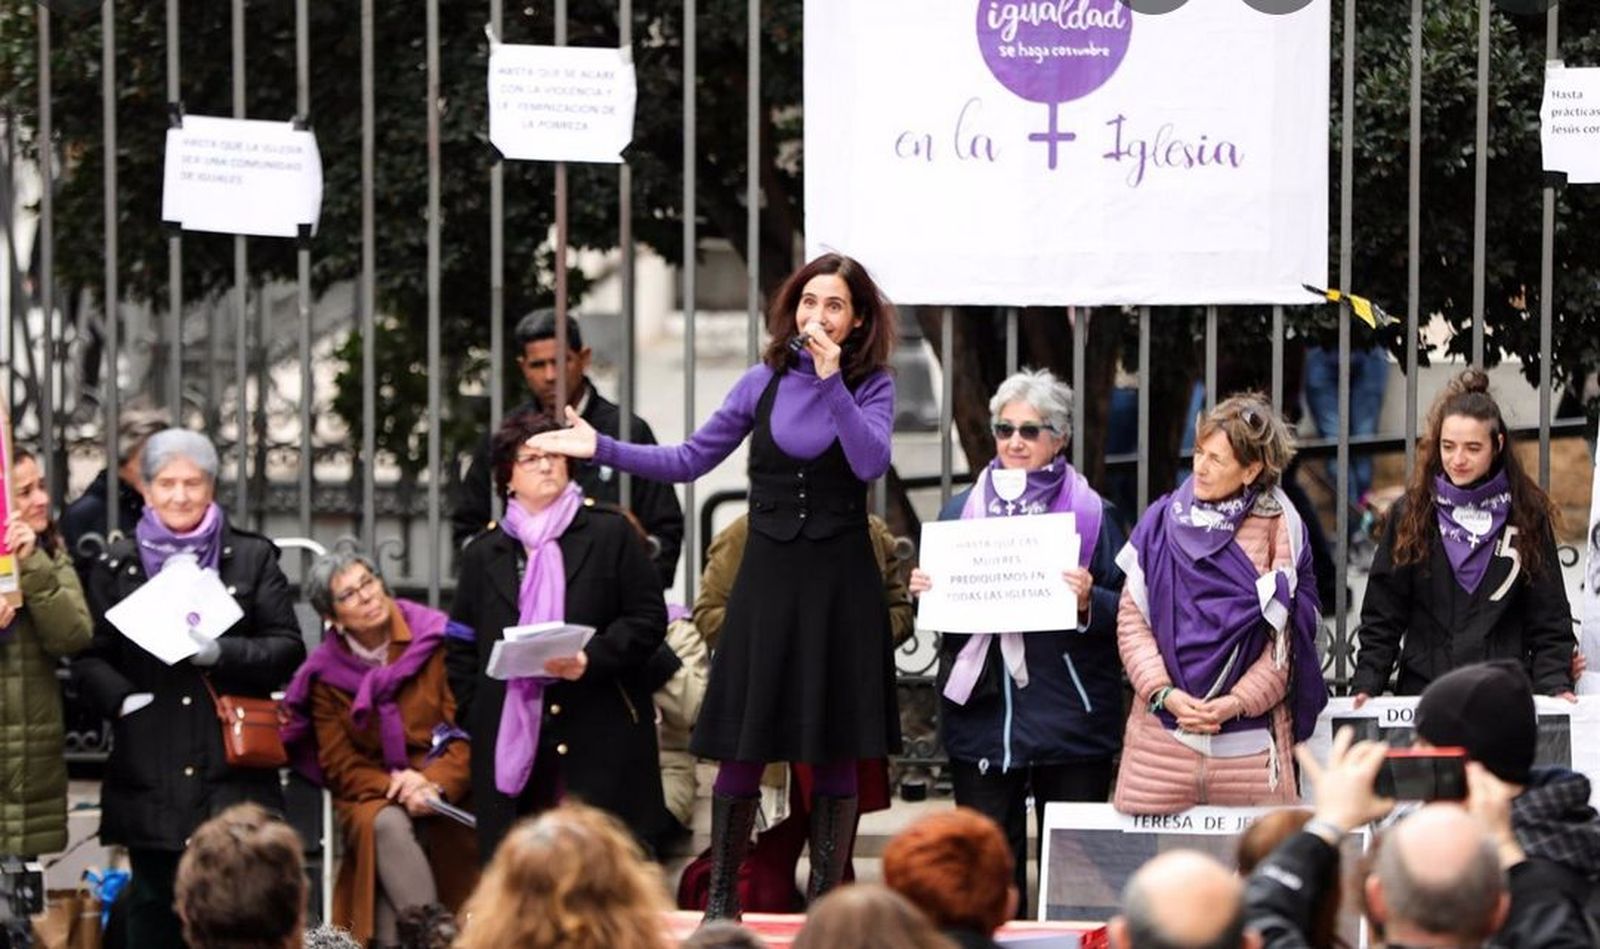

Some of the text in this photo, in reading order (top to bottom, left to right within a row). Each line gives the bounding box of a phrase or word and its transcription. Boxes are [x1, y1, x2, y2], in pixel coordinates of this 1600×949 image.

[987, 0, 1126, 43] igualdad
[998, 45, 1015, 58] se
[1018, 42, 1050, 64] haga
[1551, 89, 1583, 100] Hasta
[1551, 124, 1580, 135] Jesús
[895, 97, 1245, 188] en la Iglesia
[950, 570, 1045, 585] PREDIQUEMOS EN
[983, 590, 1003, 601] LAS
[1005, 587, 1052, 600] IGLESIAS
[1133, 813, 1193, 829] TERESA
[1204, 816, 1227, 830] DE
